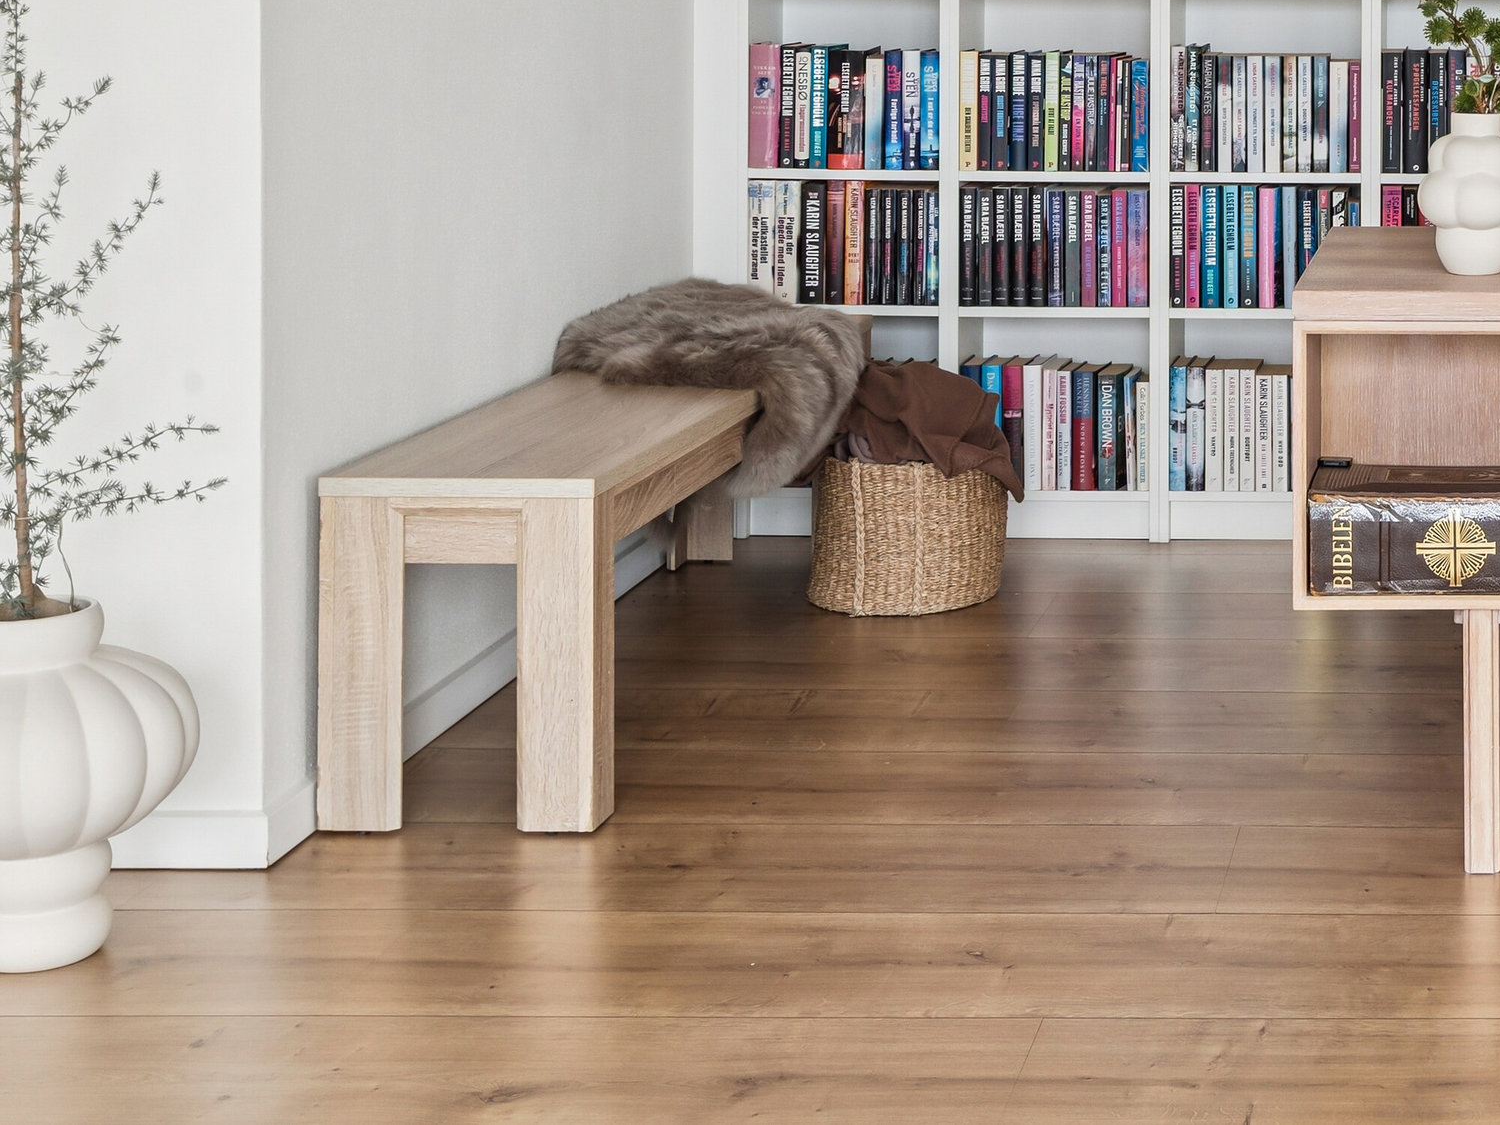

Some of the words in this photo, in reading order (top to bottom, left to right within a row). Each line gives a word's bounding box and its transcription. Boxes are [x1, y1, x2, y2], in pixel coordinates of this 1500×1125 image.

[813, 48, 827, 89] ELSEBETH
[1013, 54, 1025, 76] ANNA
[1203, 59, 1213, 89] MARIAN
[797, 62, 809, 101] NESBØ
[1013, 75, 1025, 96] GRUE
[813, 91, 827, 127] EGHOLM
[1203, 90, 1213, 115] KEYES
[1386, 79, 1394, 125] KULMANDEN
[805, 199, 820, 230] KARIN
[963, 194, 973, 215] SARA
[1100, 198, 1109, 219] SARA
[1172, 188, 1184, 219] ELSEBETH
[785, 216, 796, 240] Pigen
[963, 215, 973, 243] BLÆDEL
[1172, 222, 1184, 256] EGHOLM
[785, 241, 796, 256] der
[805, 231, 820, 287] SLAUGHTER
[1083, 376, 1091, 415] HENNING
[1101, 385, 1114, 408] DAN
[1259, 378, 1269, 400] KARIN
[1101, 408, 1114, 448] BROWN
[1259, 400, 1269, 441] SLAUGHTER
[1332, 504, 1353, 590] BIBELEN
